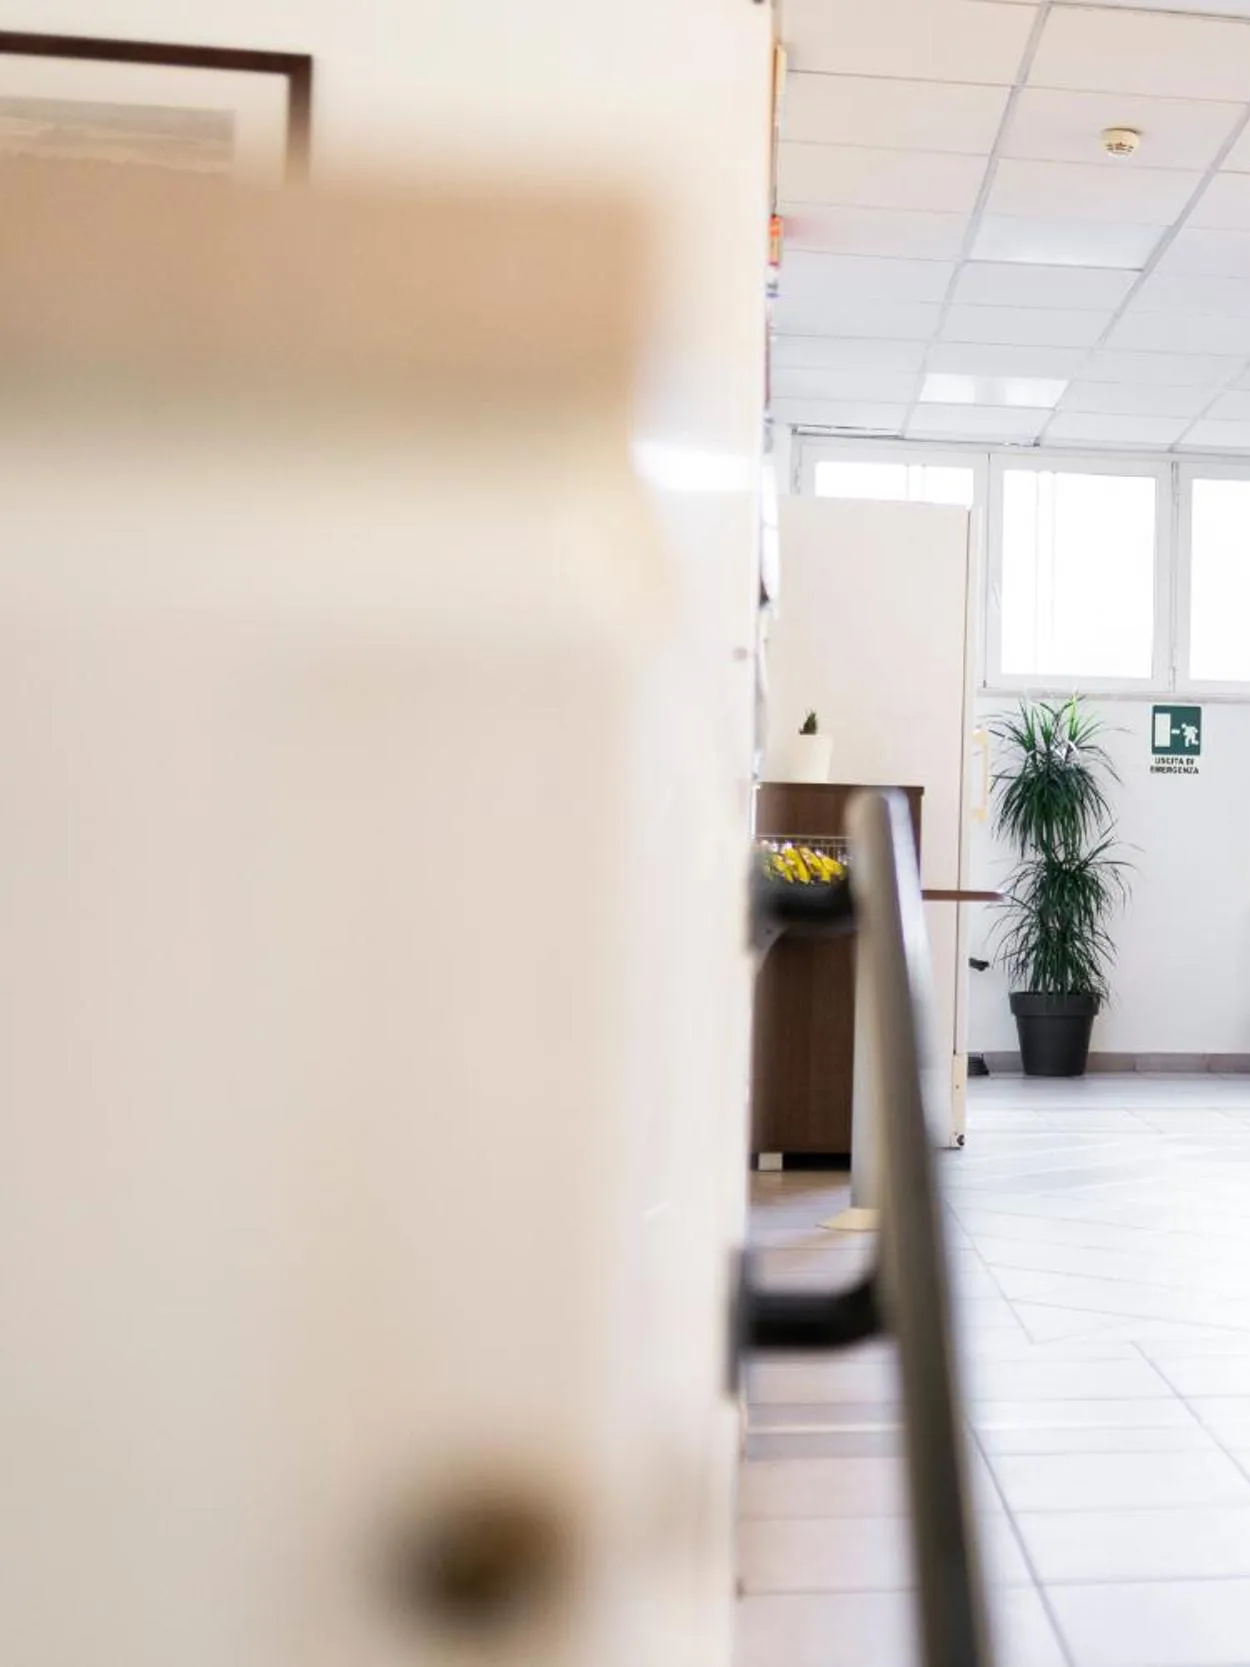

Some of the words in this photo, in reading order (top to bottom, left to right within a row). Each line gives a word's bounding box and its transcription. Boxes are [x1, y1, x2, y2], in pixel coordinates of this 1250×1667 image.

[1155, 757, 1184, 765] USCITA
[1186, 757, 1194, 765] DI
[1150, 766, 1199, 774] EMERGENZA
